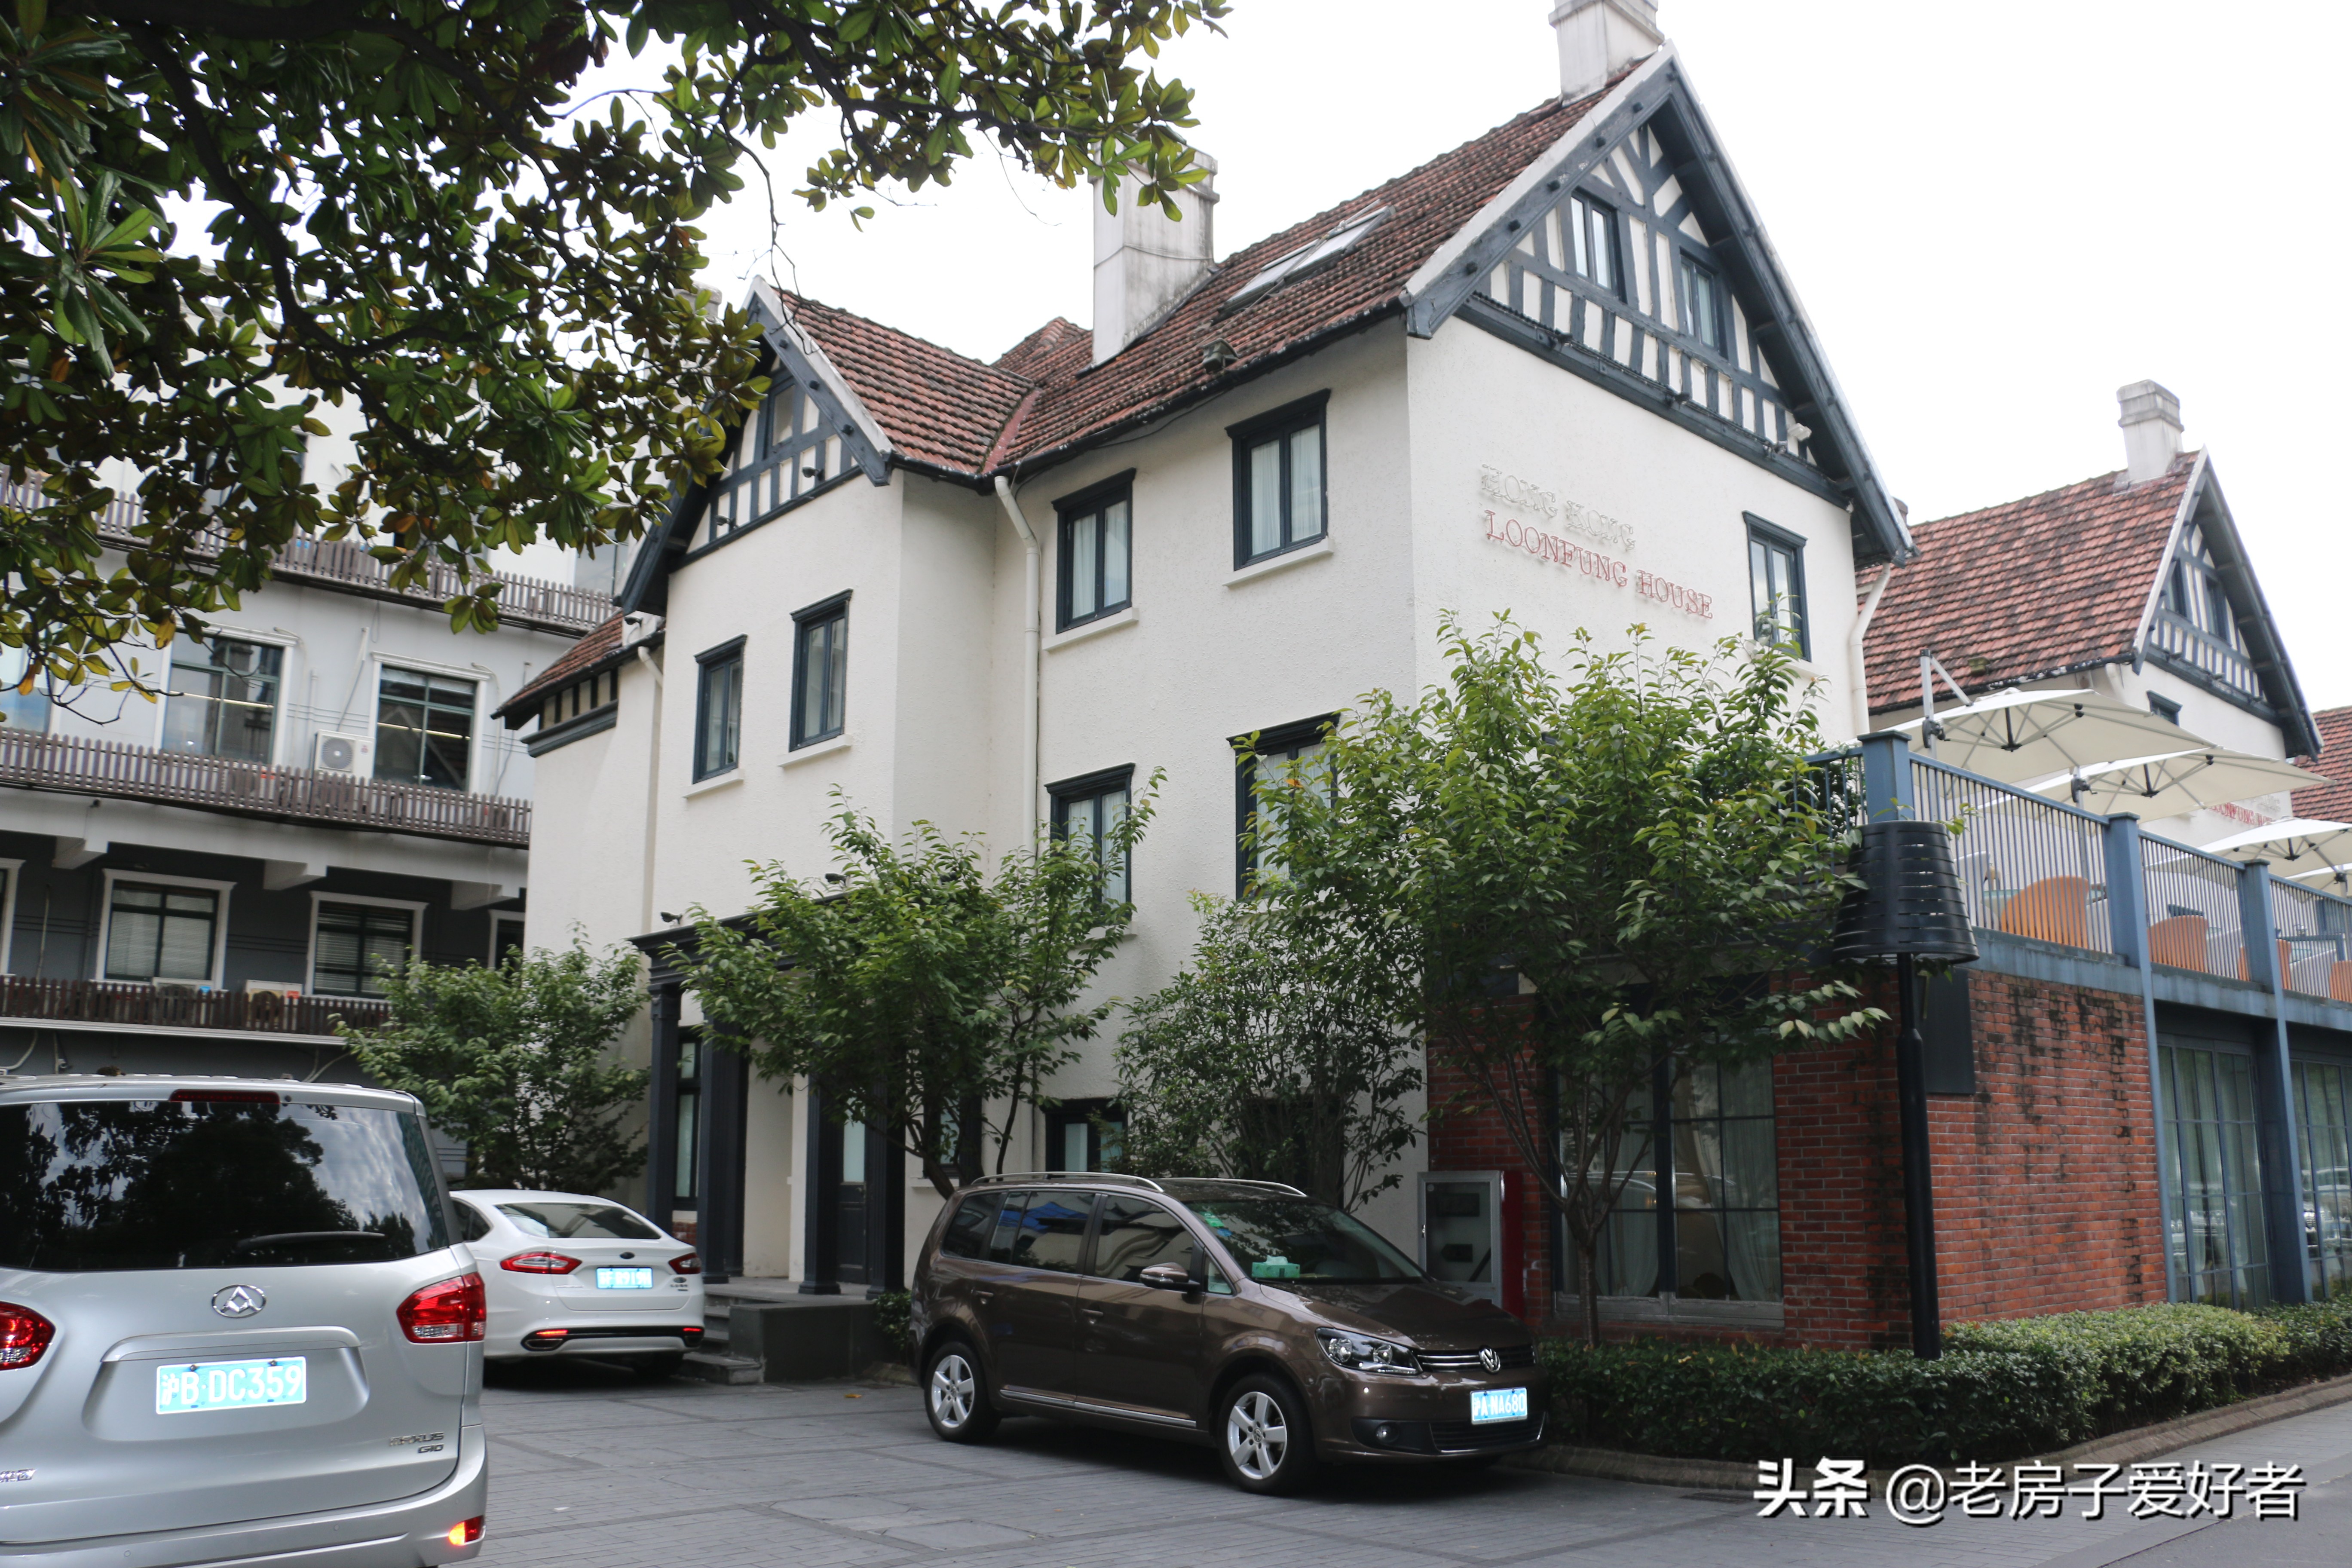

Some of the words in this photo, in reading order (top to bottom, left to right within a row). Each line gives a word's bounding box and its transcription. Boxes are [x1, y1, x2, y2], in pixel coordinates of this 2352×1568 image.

[1482, 464, 1558, 518] HONG
[1566, 500, 1636, 551] KONG
[1484, 509, 1628, 587] LOONFUNG
[1636, 569, 1713, 619] HOUSE
